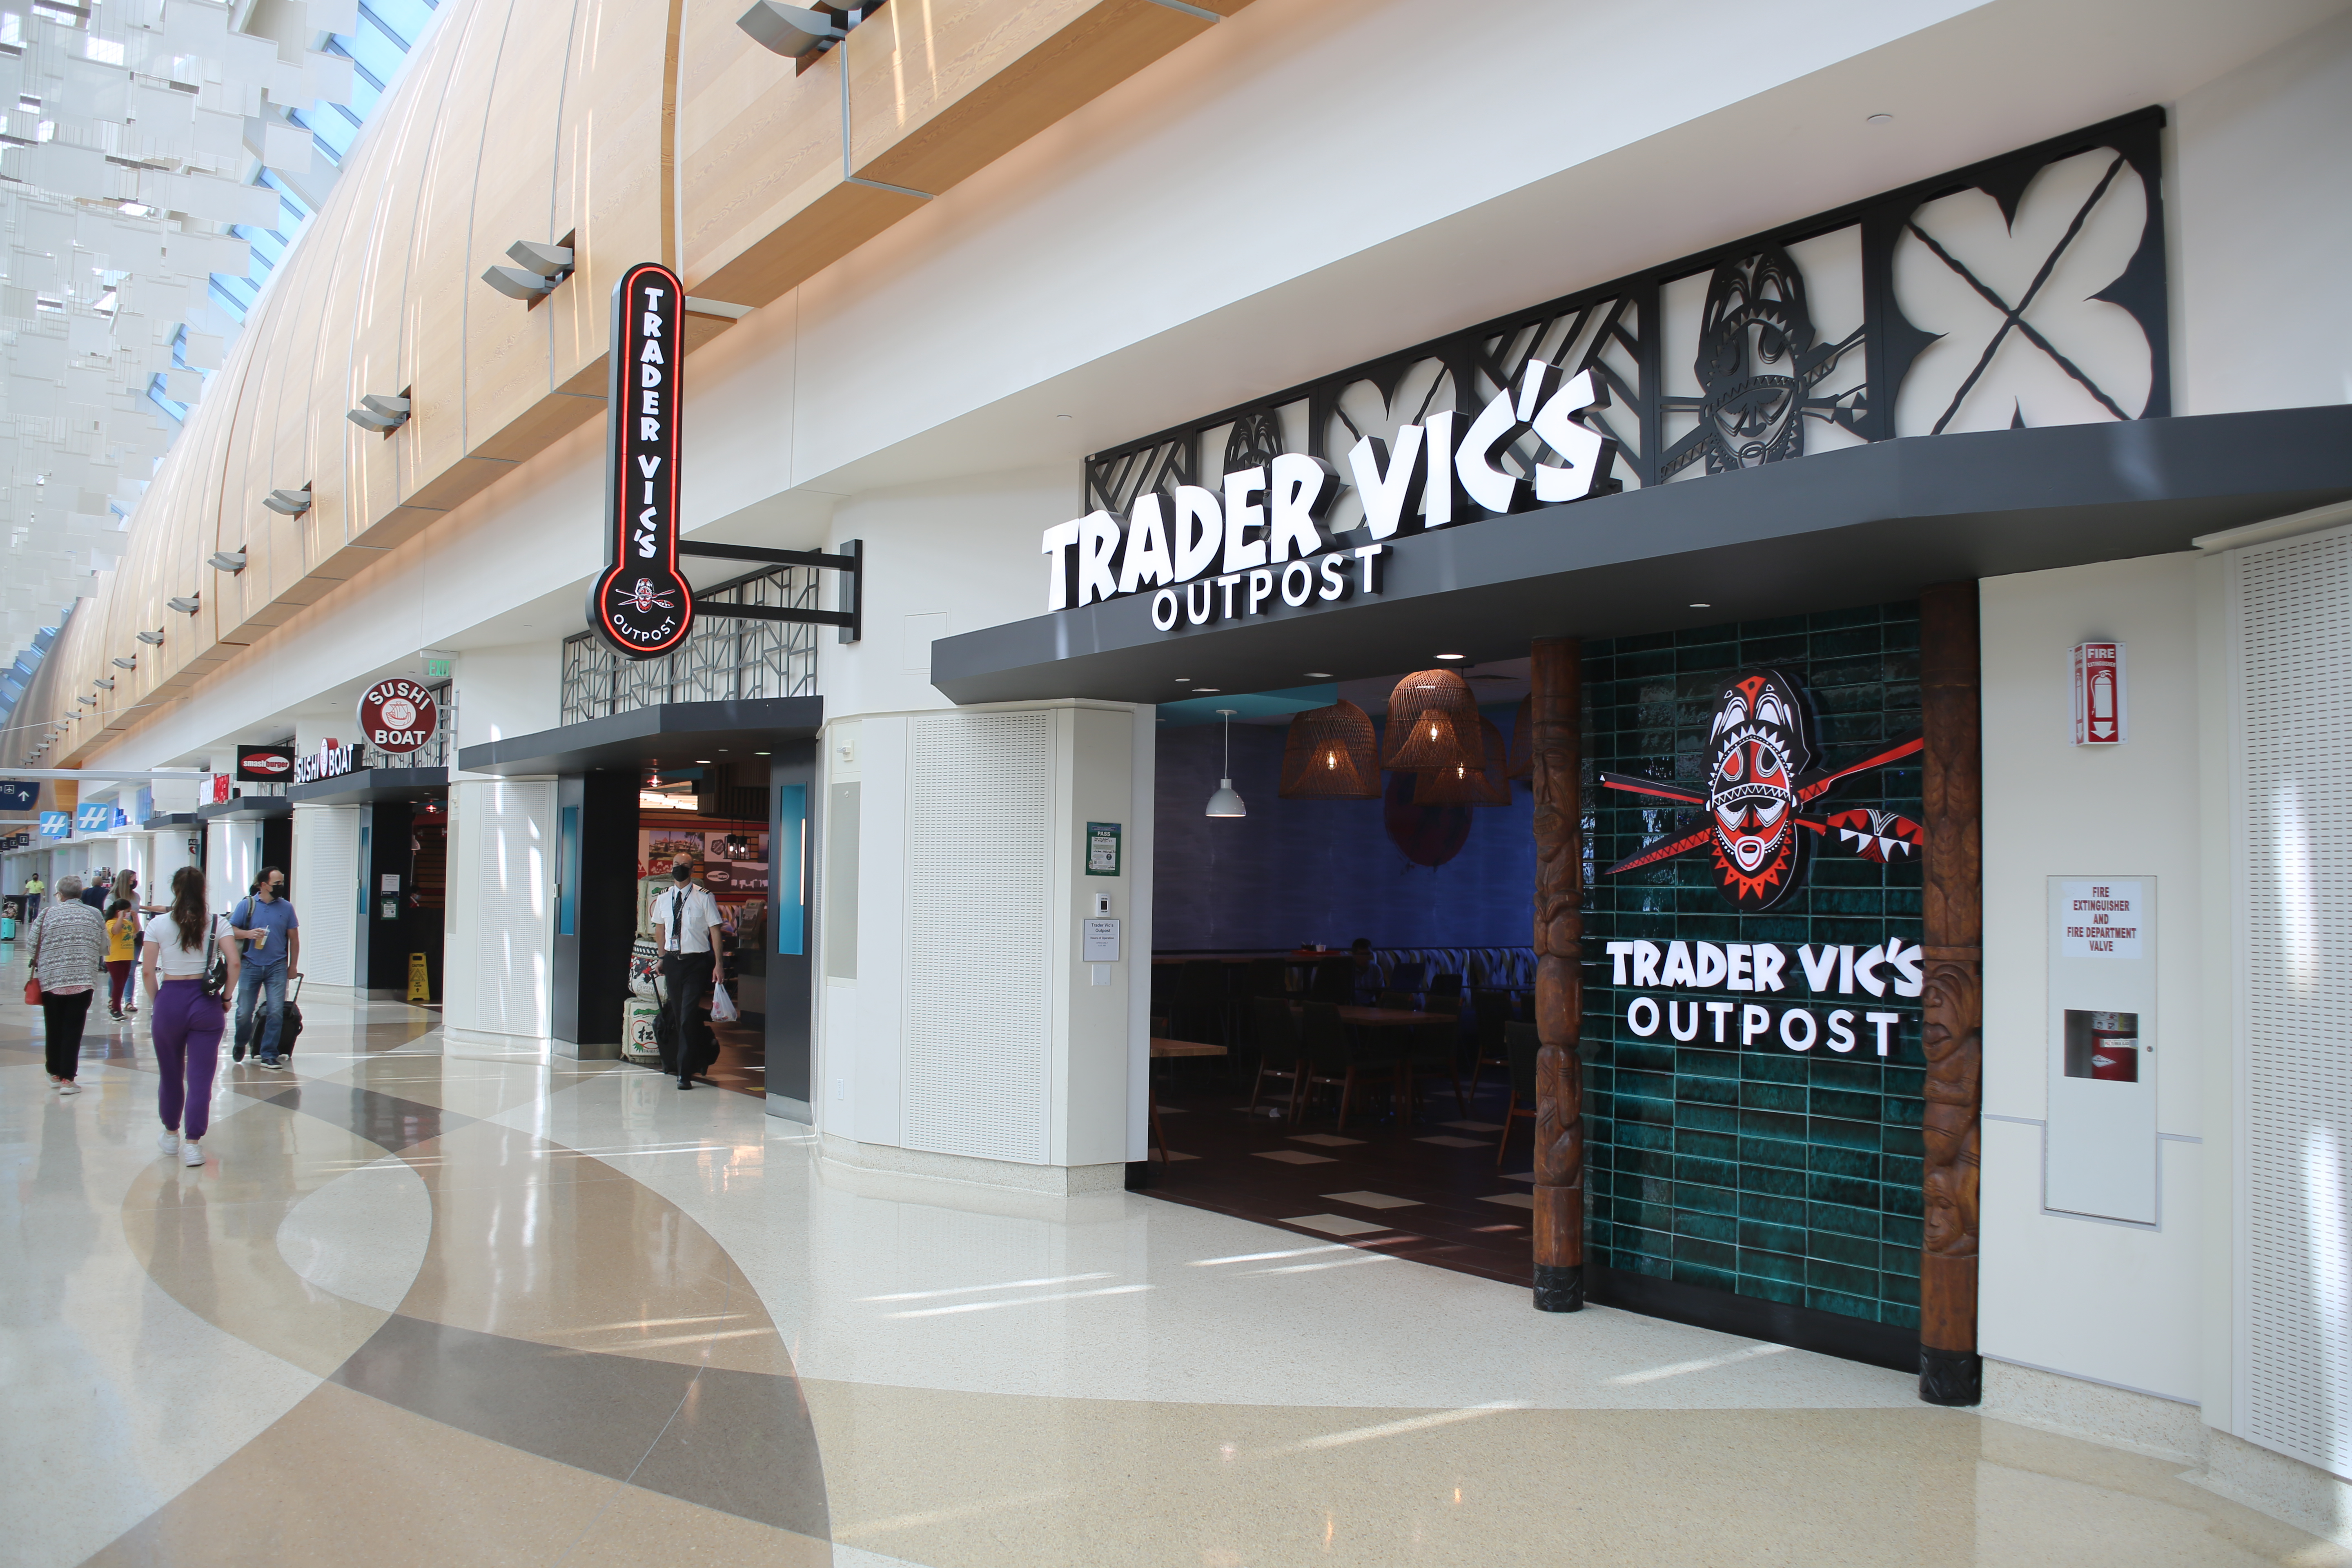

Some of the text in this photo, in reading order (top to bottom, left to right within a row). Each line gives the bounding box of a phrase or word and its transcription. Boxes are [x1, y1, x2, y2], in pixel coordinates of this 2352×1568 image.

[633, 287, 664, 559] TRADER VIC'S
[1042, 359, 1604, 612] TRADER VIC'S
[1152, 543, 1383, 632] OUTPOST
[613, 613, 676, 642] OUTPOST
[2087, 648, 2115, 659] FIRE
[429, 659, 450, 677] EXIT
[368, 682, 431, 710] SUSHI
[374, 729, 426, 745] BOAT
[243, 760, 289, 768] smashburger
[297, 743, 354, 783] SUSHI BOAT
[2092, 886, 2109, 898] FIRE
[2073, 900, 2130, 911] EXTINGUISHER
[2093, 913, 2109, 924] AND
[2067, 927, 2136, 938] FIRE DEPARTMENT
[2089, 940, 2114, 952] VALVE
[1606, 936, 1924, 998] TRADER VIC'S
[638, 1026, 653, 1042] 松
[1627, 996, 1900, 1056] OUTPOST
